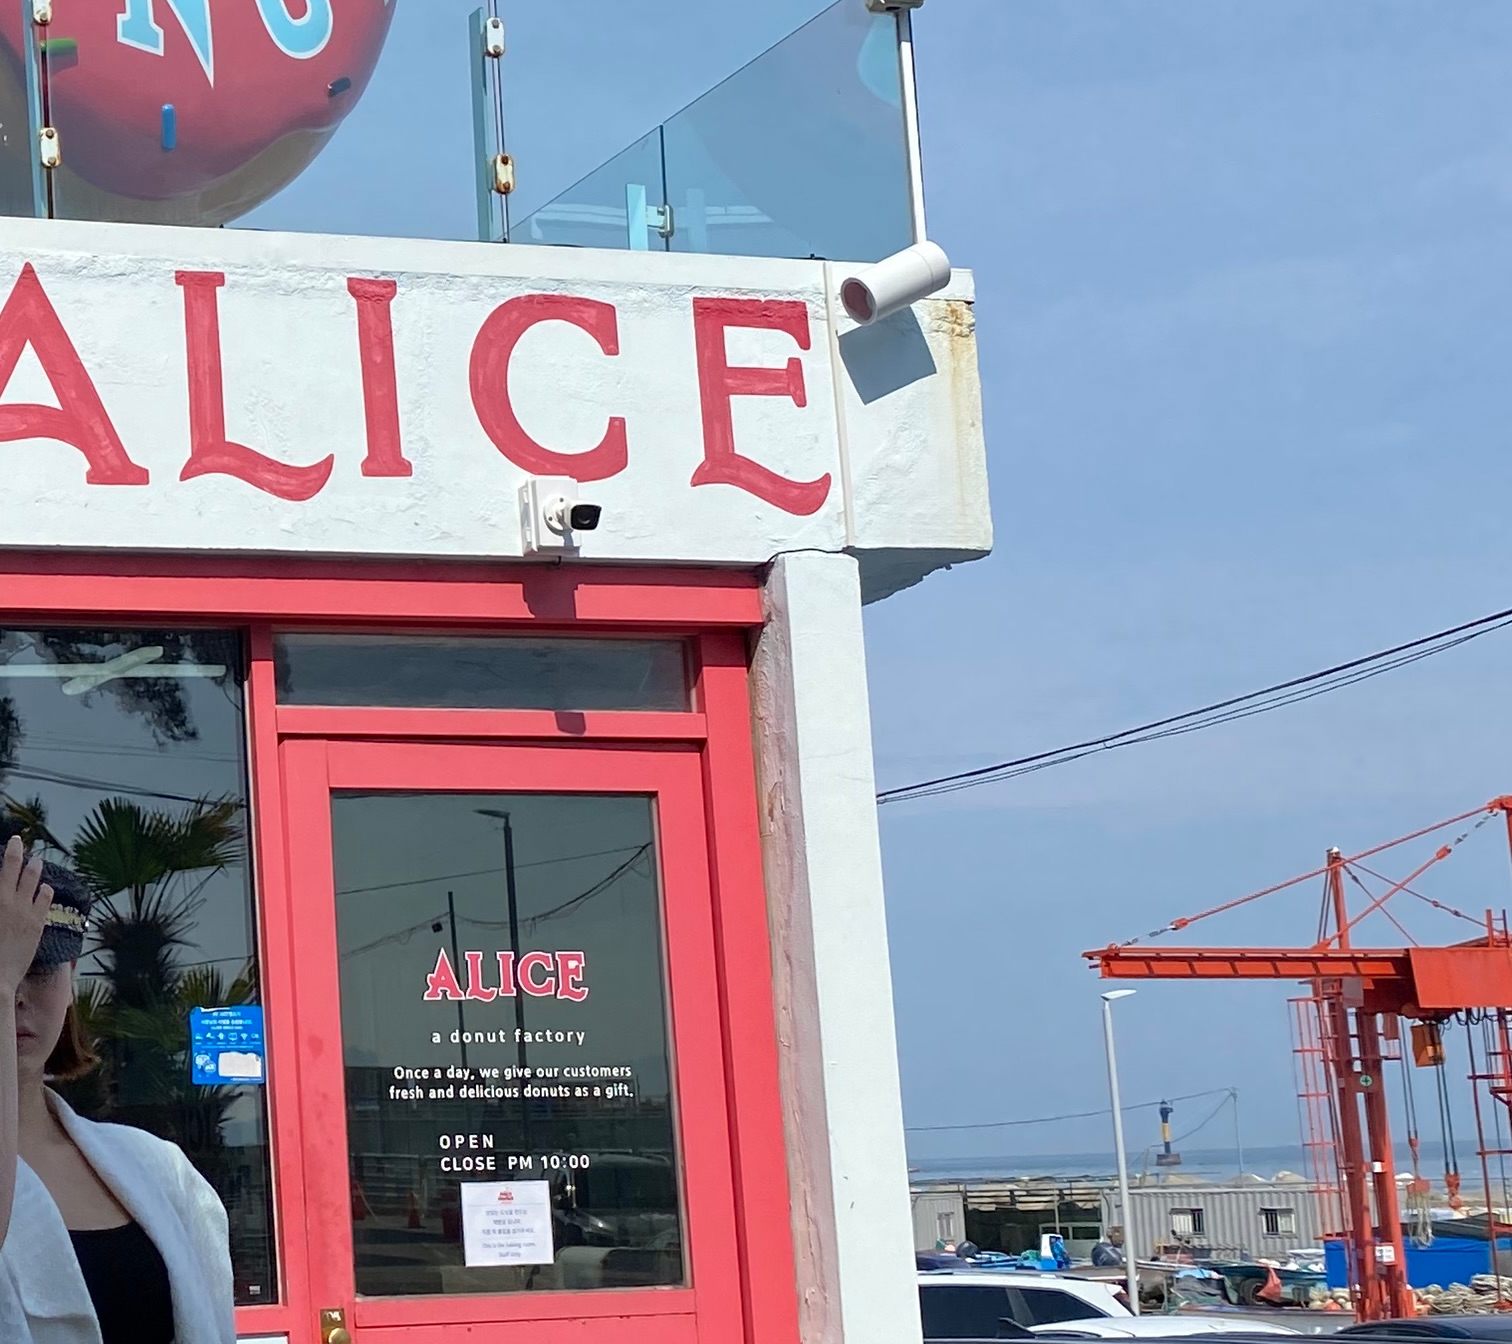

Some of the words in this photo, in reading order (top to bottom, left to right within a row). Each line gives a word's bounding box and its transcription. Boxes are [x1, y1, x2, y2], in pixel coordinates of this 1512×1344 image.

[423, 946, 590, 1003] ALICE
[431, 1032, 441, 1044] a
[450, 1029, 506, 1044] donut
[514, 1028, 585, 1046] factory
[393, 1066, 429, 1080] Once
[433, 1068, 442, 1079] a
[446, 1064, 475, 1081] day,
[479, 1068, 500, 1078] we
[503, 1064, 532, 1081] give
[536, 1067, 559, 1078] our
[563, 1064, 632, 1078] customers
[389, 1085, 424, 1100] fresh
[429, 1084, 454, 1099] and
[459, 1084, 519, 1099] delicious
[523, 1083, 571, 1098] donuts
[574, 1086, 589, 1097] as
[593, 1086, 601, 1097] a
[605, 1082, 634, 1099] gift.
[439, 1134, 494, 1150] OPEN
[440, 1156, 496, 1172] CLOSE
[508, 1155, 533, 1170] PM
[540, 1154, 590, 1170] 10:00
